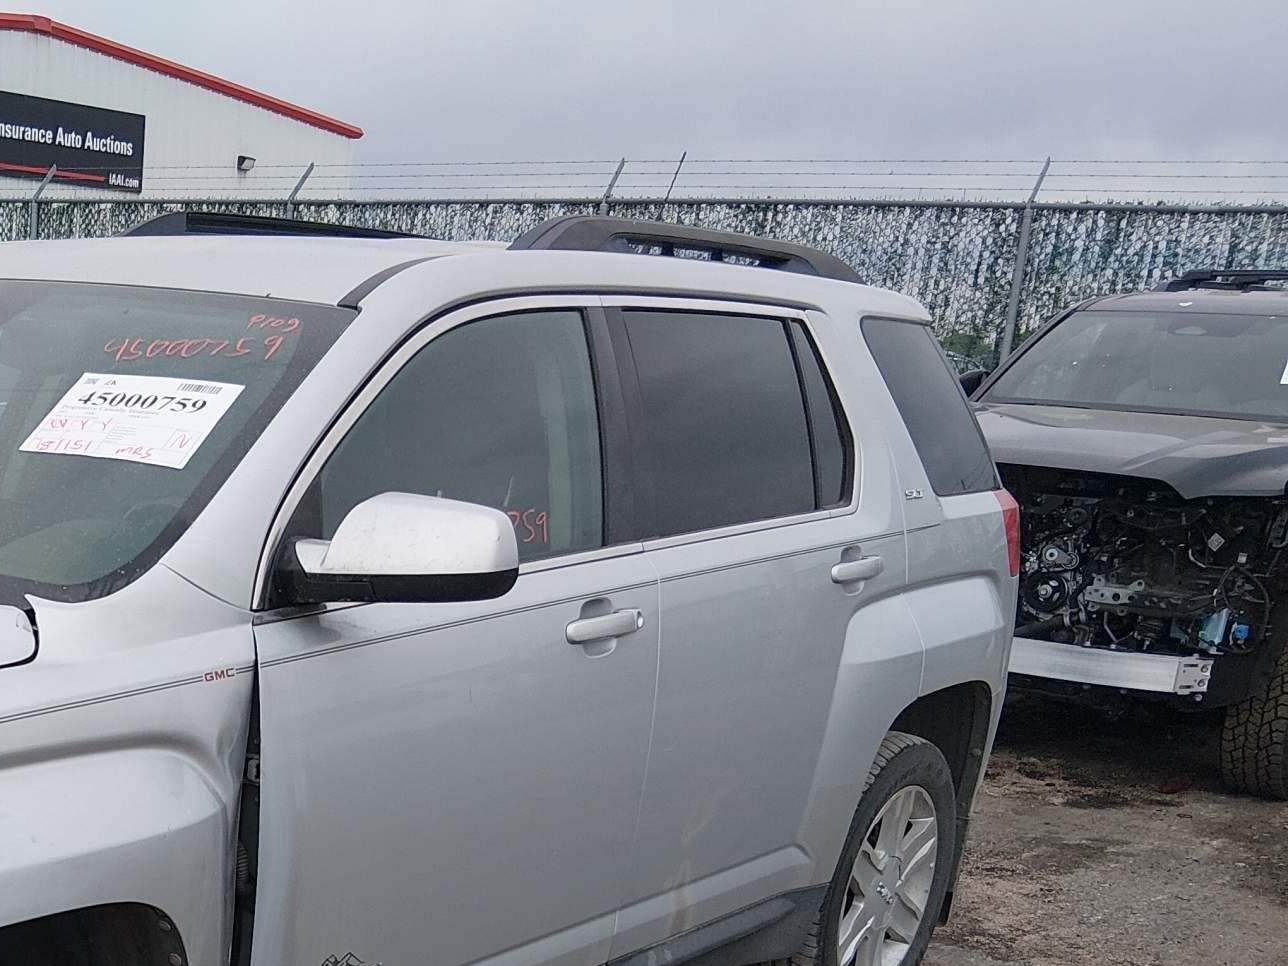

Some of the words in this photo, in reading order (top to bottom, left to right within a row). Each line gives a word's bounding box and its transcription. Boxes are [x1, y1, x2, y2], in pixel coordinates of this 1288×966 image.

[55, 127, 82, 149] Auto
[85, 135, 133, 156] Auctions
[108, 173, 140, 188] IAAI.com
[104, 335, 284, 361] 45000759
[77, 391, 207, 414] 45000759
[205, 668, 234, 682] GMC
